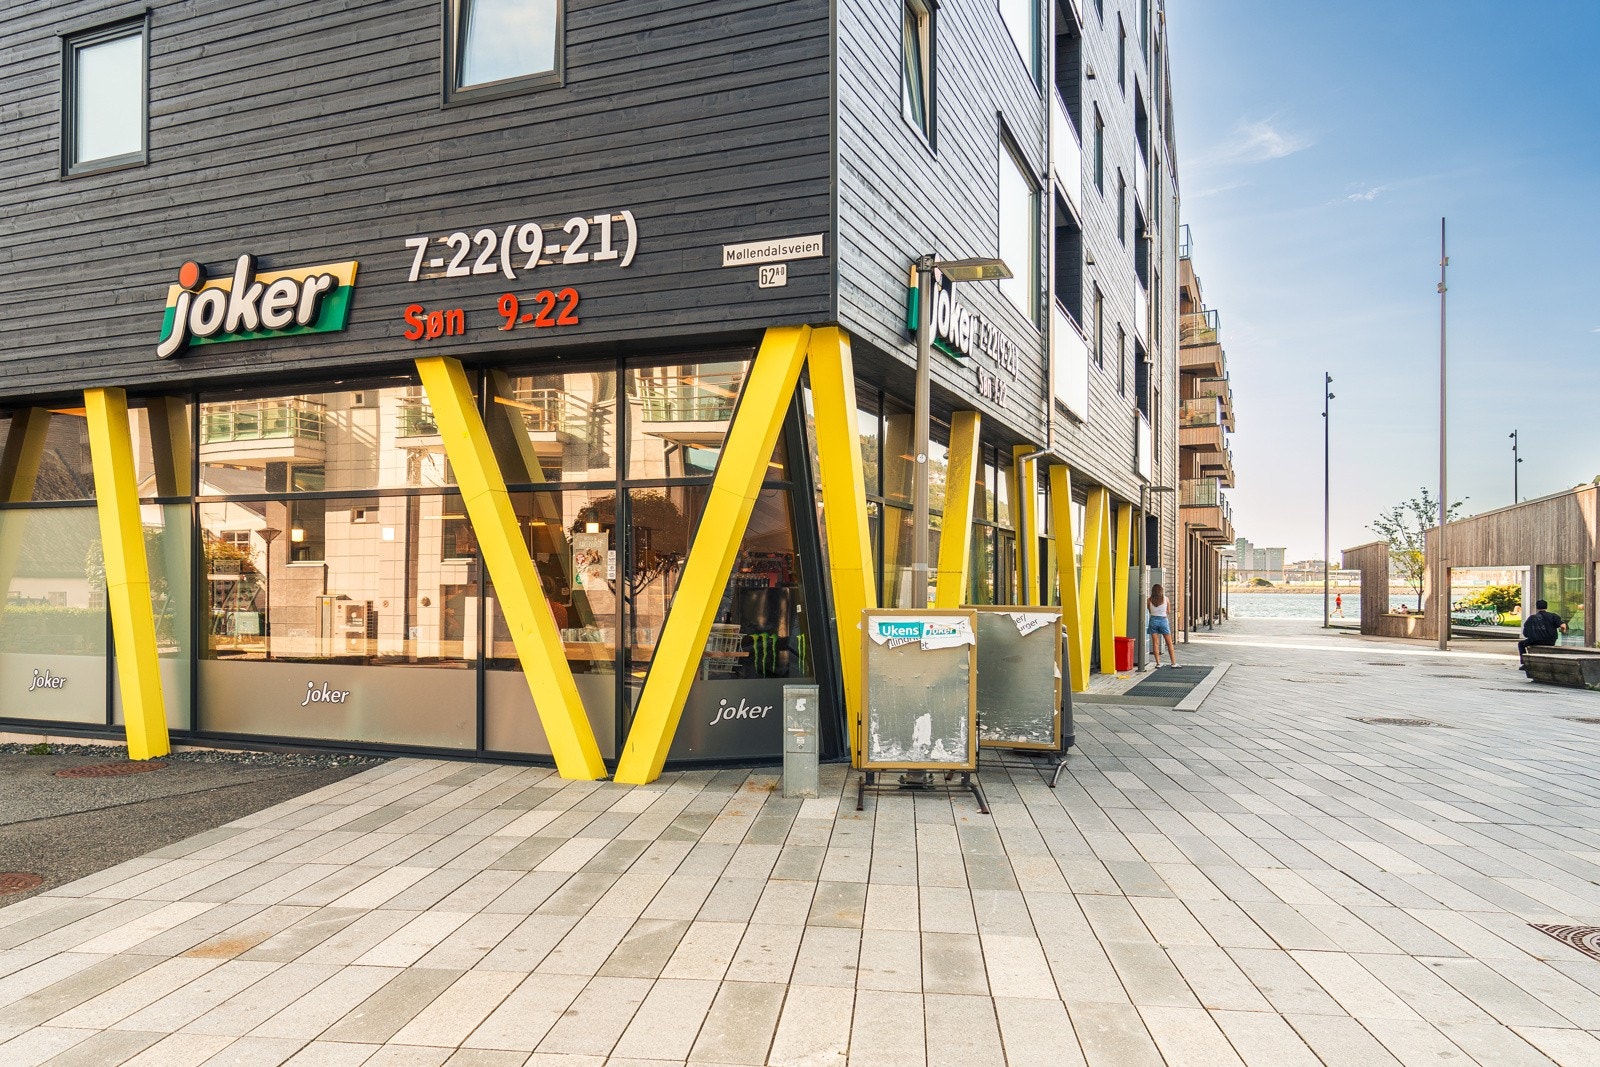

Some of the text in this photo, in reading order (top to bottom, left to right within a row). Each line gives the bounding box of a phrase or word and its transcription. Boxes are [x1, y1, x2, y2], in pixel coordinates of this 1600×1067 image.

[405, 210, 637, 282] 7-22(9-21)
[726, 241, 820, 261] Møllendalsveien
[156, 252, 338, 360] joker
[403, 287, 580, 341] Søn 9-22
[882, 625, 920, 636] Ukens
[29, 668, 67, 691] joker
[301, 681, 350, 706] joker
[709, 698, 773, 726] joker
